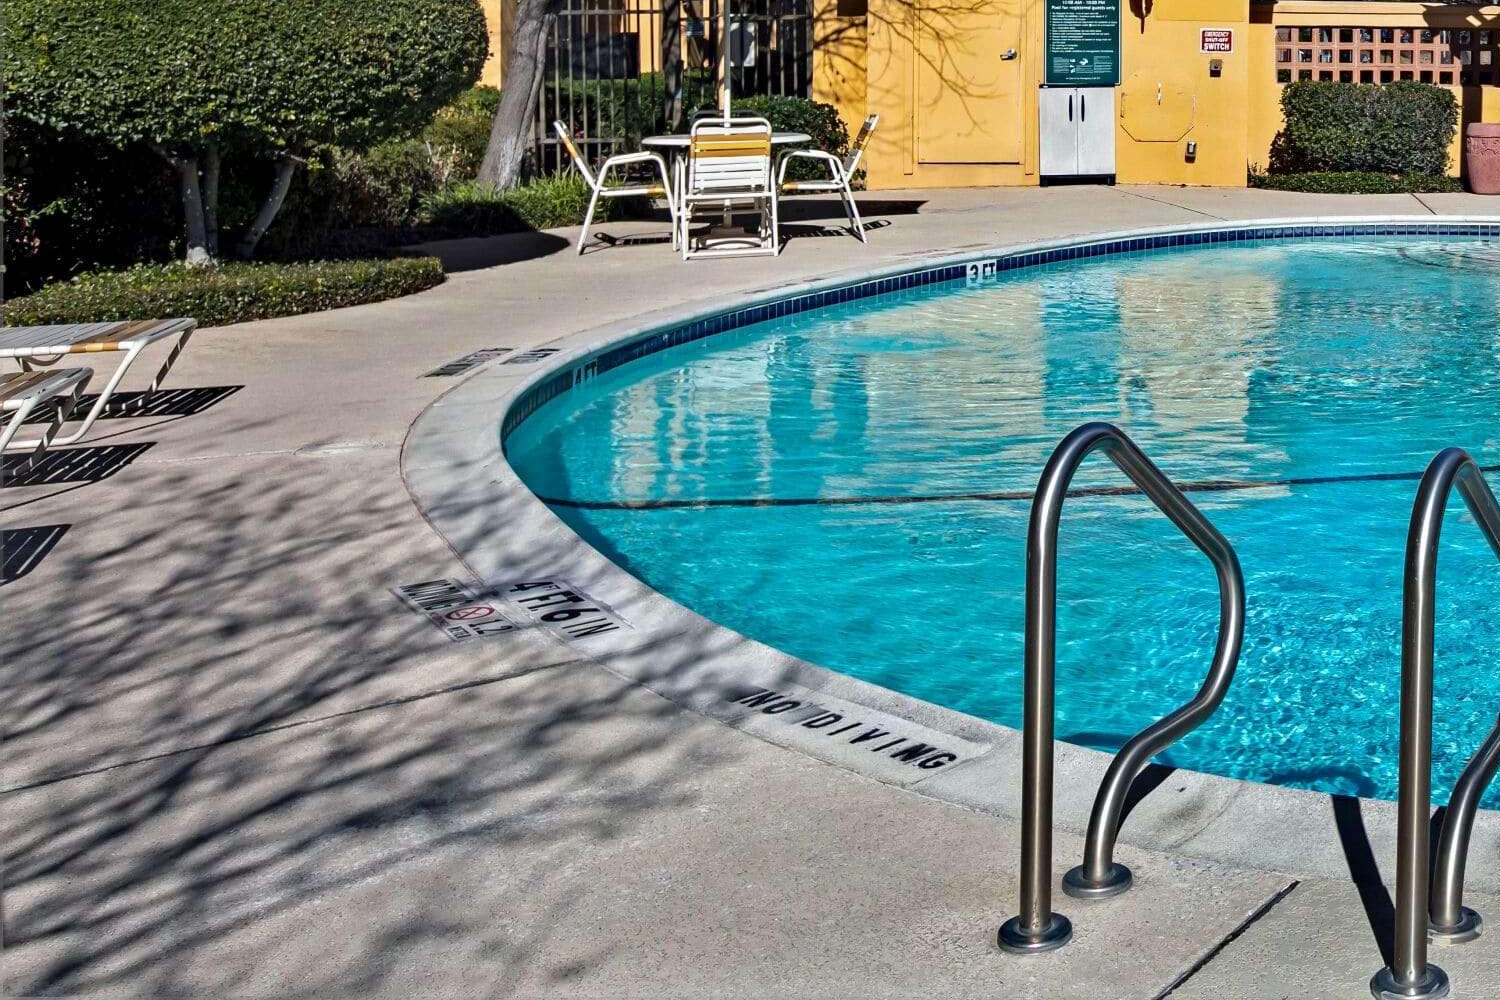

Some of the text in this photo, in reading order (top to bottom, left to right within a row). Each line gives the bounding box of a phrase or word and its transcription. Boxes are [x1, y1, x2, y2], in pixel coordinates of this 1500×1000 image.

[1203, 43, 1230, 51] SWITCH
[969, 263, 995, 282] 3 FT
[540, 607, 601, 623] 6
[561, 617, 620, 638] IN
[729, 688, 957, 769] NO DIVING
